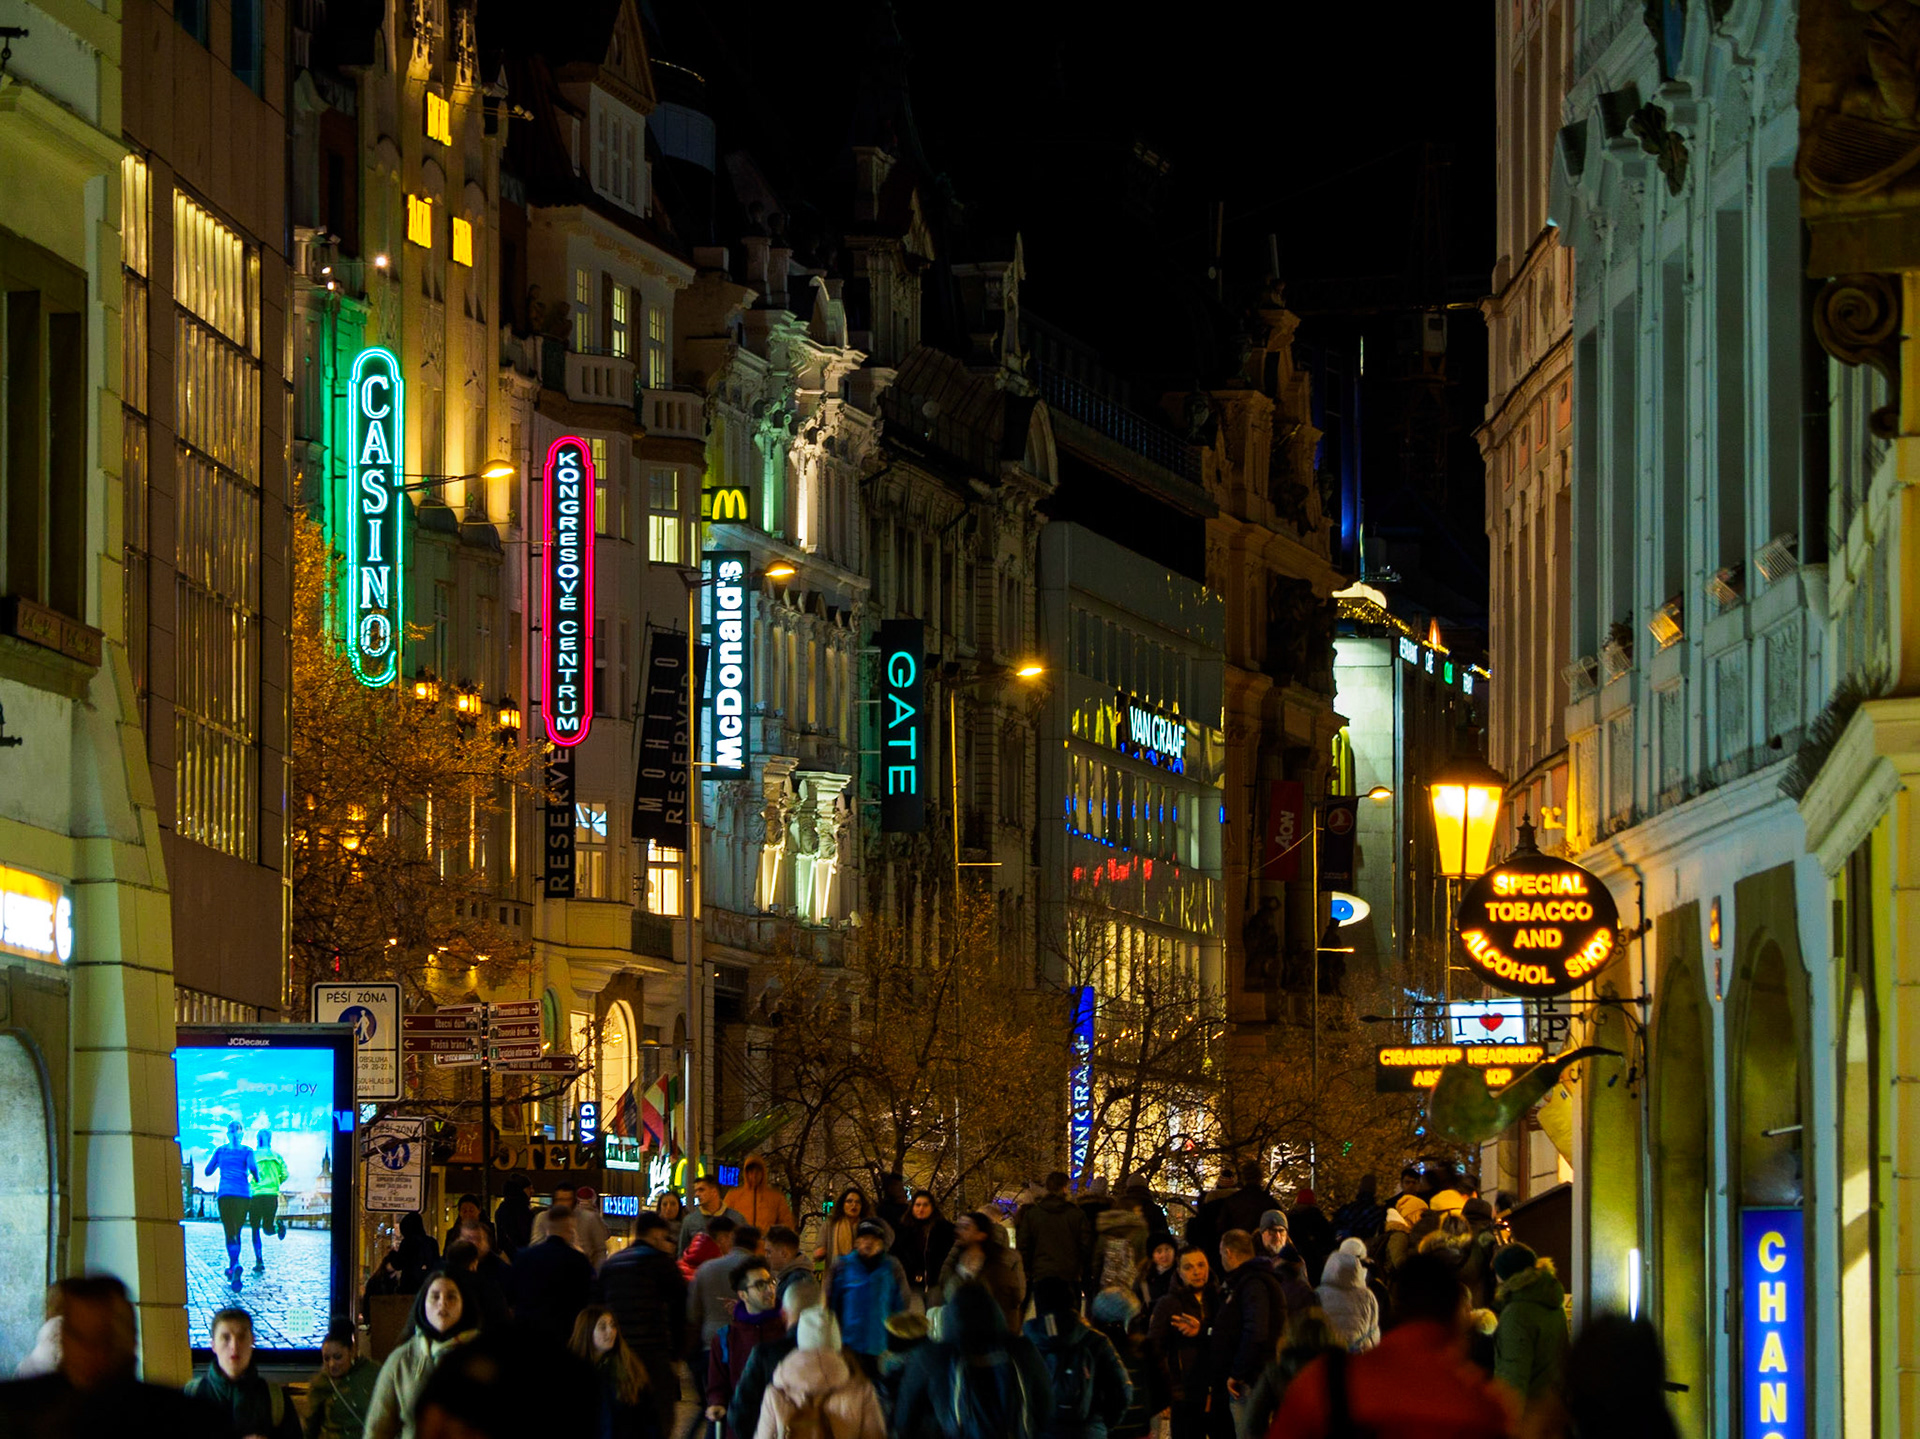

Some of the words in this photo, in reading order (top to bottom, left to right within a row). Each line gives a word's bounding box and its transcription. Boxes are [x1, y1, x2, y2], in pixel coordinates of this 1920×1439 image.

[360, 374, 392, 657] CASINO
[557, 452, 580, 611] KONGRESOVÉ
[556, 620, 580, 732] CENTRUM
[716, 560, 743, 769] McDonald's
[637, 657, 680, 813] MOHITO
[888, 651, 916, 795] GATE
[1129, 706, 1151, 747] VAN
[1152, 715, 1186, 758] GRAAF
[549, 748, 570, 892] RESERVE
[1274, 810, 1295, 850] AON
[1492, 872, 1589, 896] SPECIAL
[1485, 901, 1594, 922] TOBACCO
[1513, 928, 1563, 949] AND
[1461, 930, 1556, 985] ALCOHOL
[1564, 928, 1613, 978] SHOP
[326, 990, 351, 1003] PĚŠÍ
[357, 990, 387, 1003] ZÓNA
[227, 1038, 270, 1046] JCDecaux
[1467, 1047, 1543, 1064] HEADSHOP
[603, 1196, 640, 1217] RESERVED
[1758, 1231, 1788, 1439] CHAN
